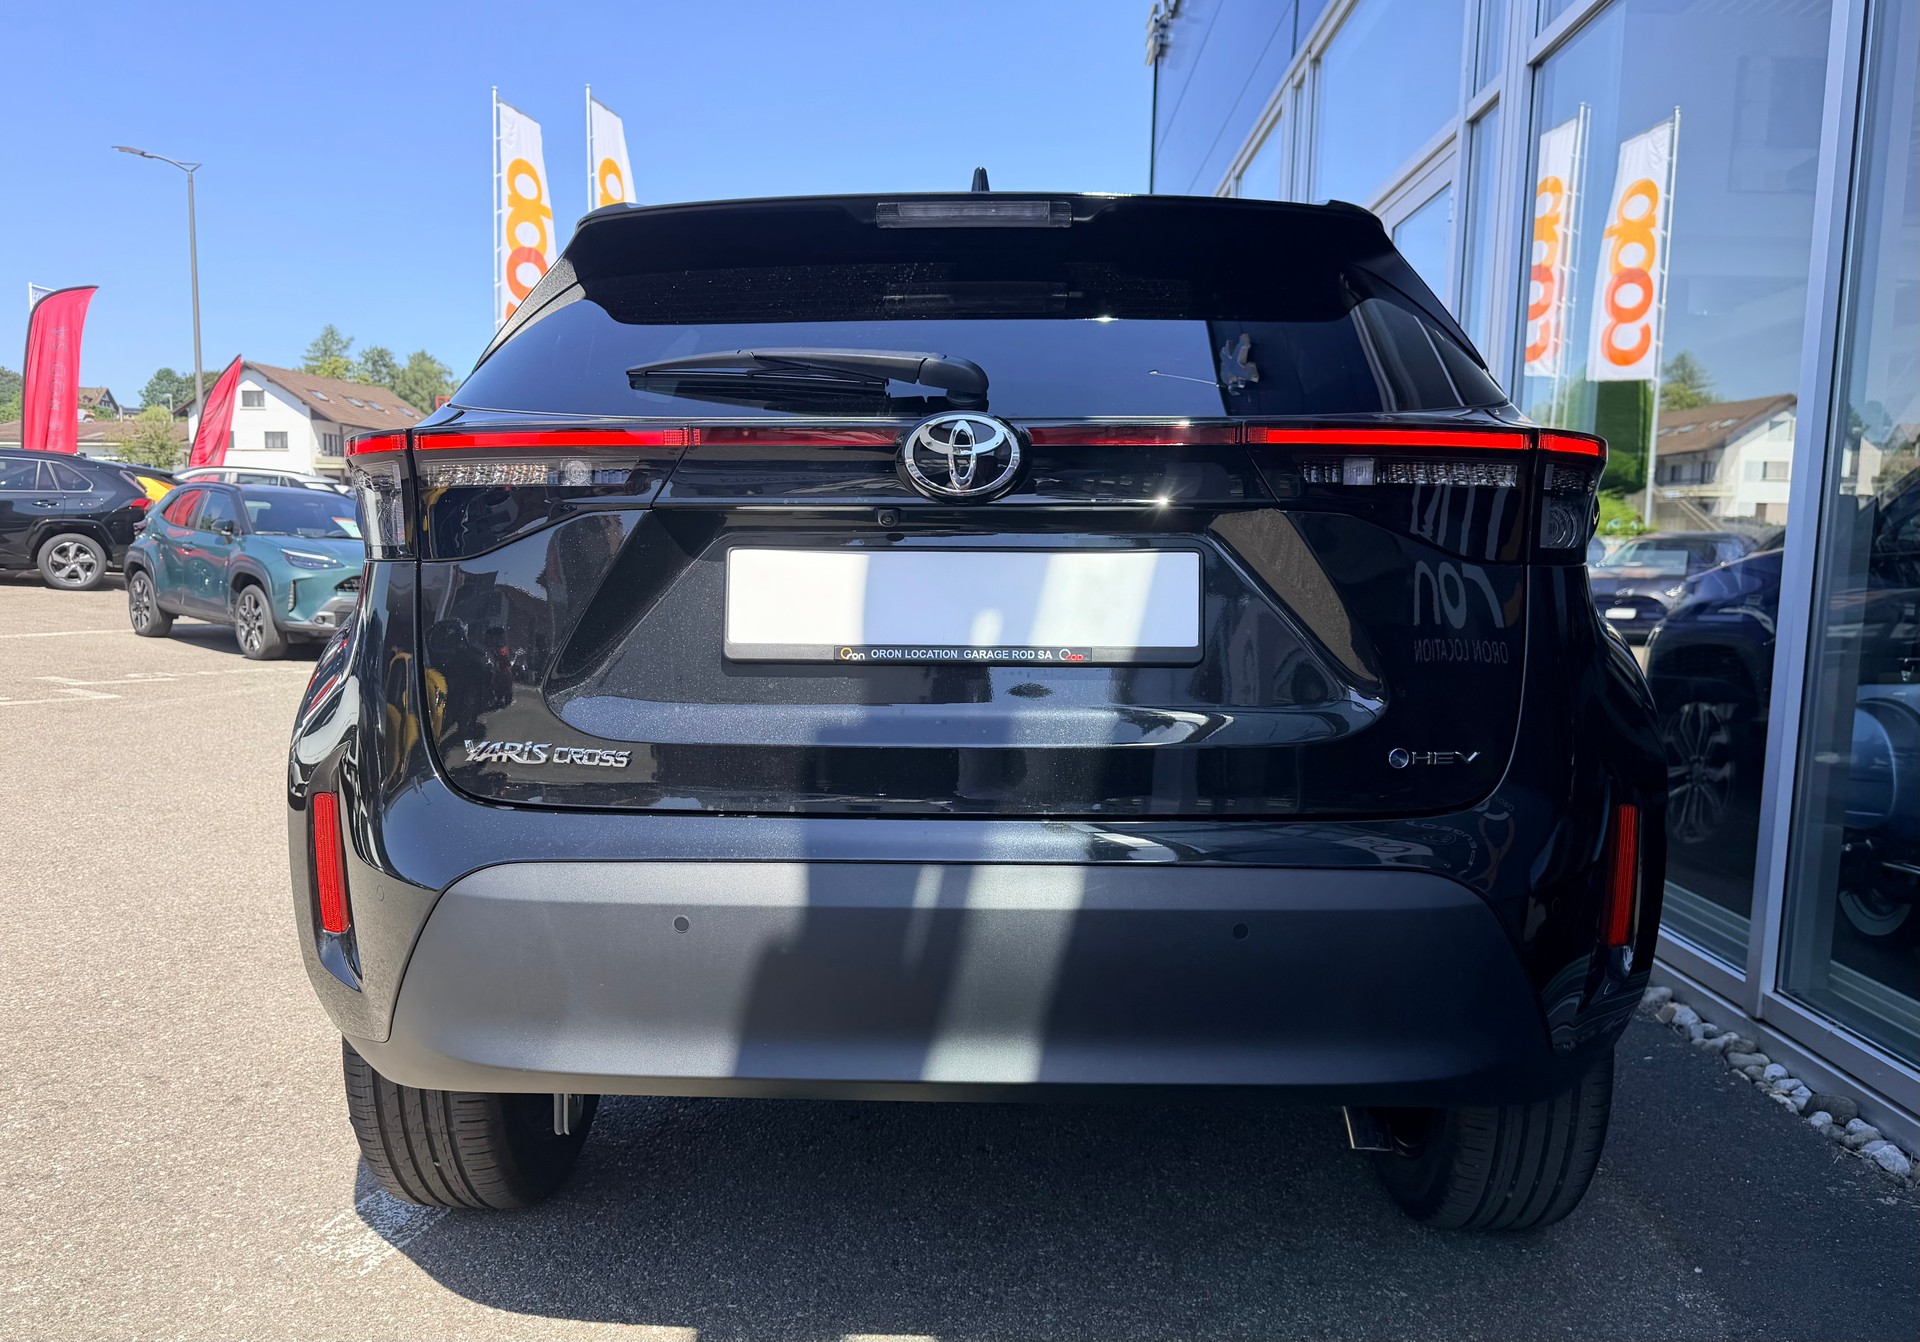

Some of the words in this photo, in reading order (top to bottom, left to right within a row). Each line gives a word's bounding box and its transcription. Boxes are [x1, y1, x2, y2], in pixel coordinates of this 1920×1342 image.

[506, 158, 553, 320] oop
[51, 326, 68, 353] SA
[871, 649, 902, 659] ORON
[905, 649, 958, 659] LOCATION
[963, 649, 1009, 660] GARAGE
[1012, 649, 1035, 660] ROD
[1037, 649, 1053, 660] SA
[552, 746, 633, 768] CROSS
[1411, 750, 1481, 766] HEV
